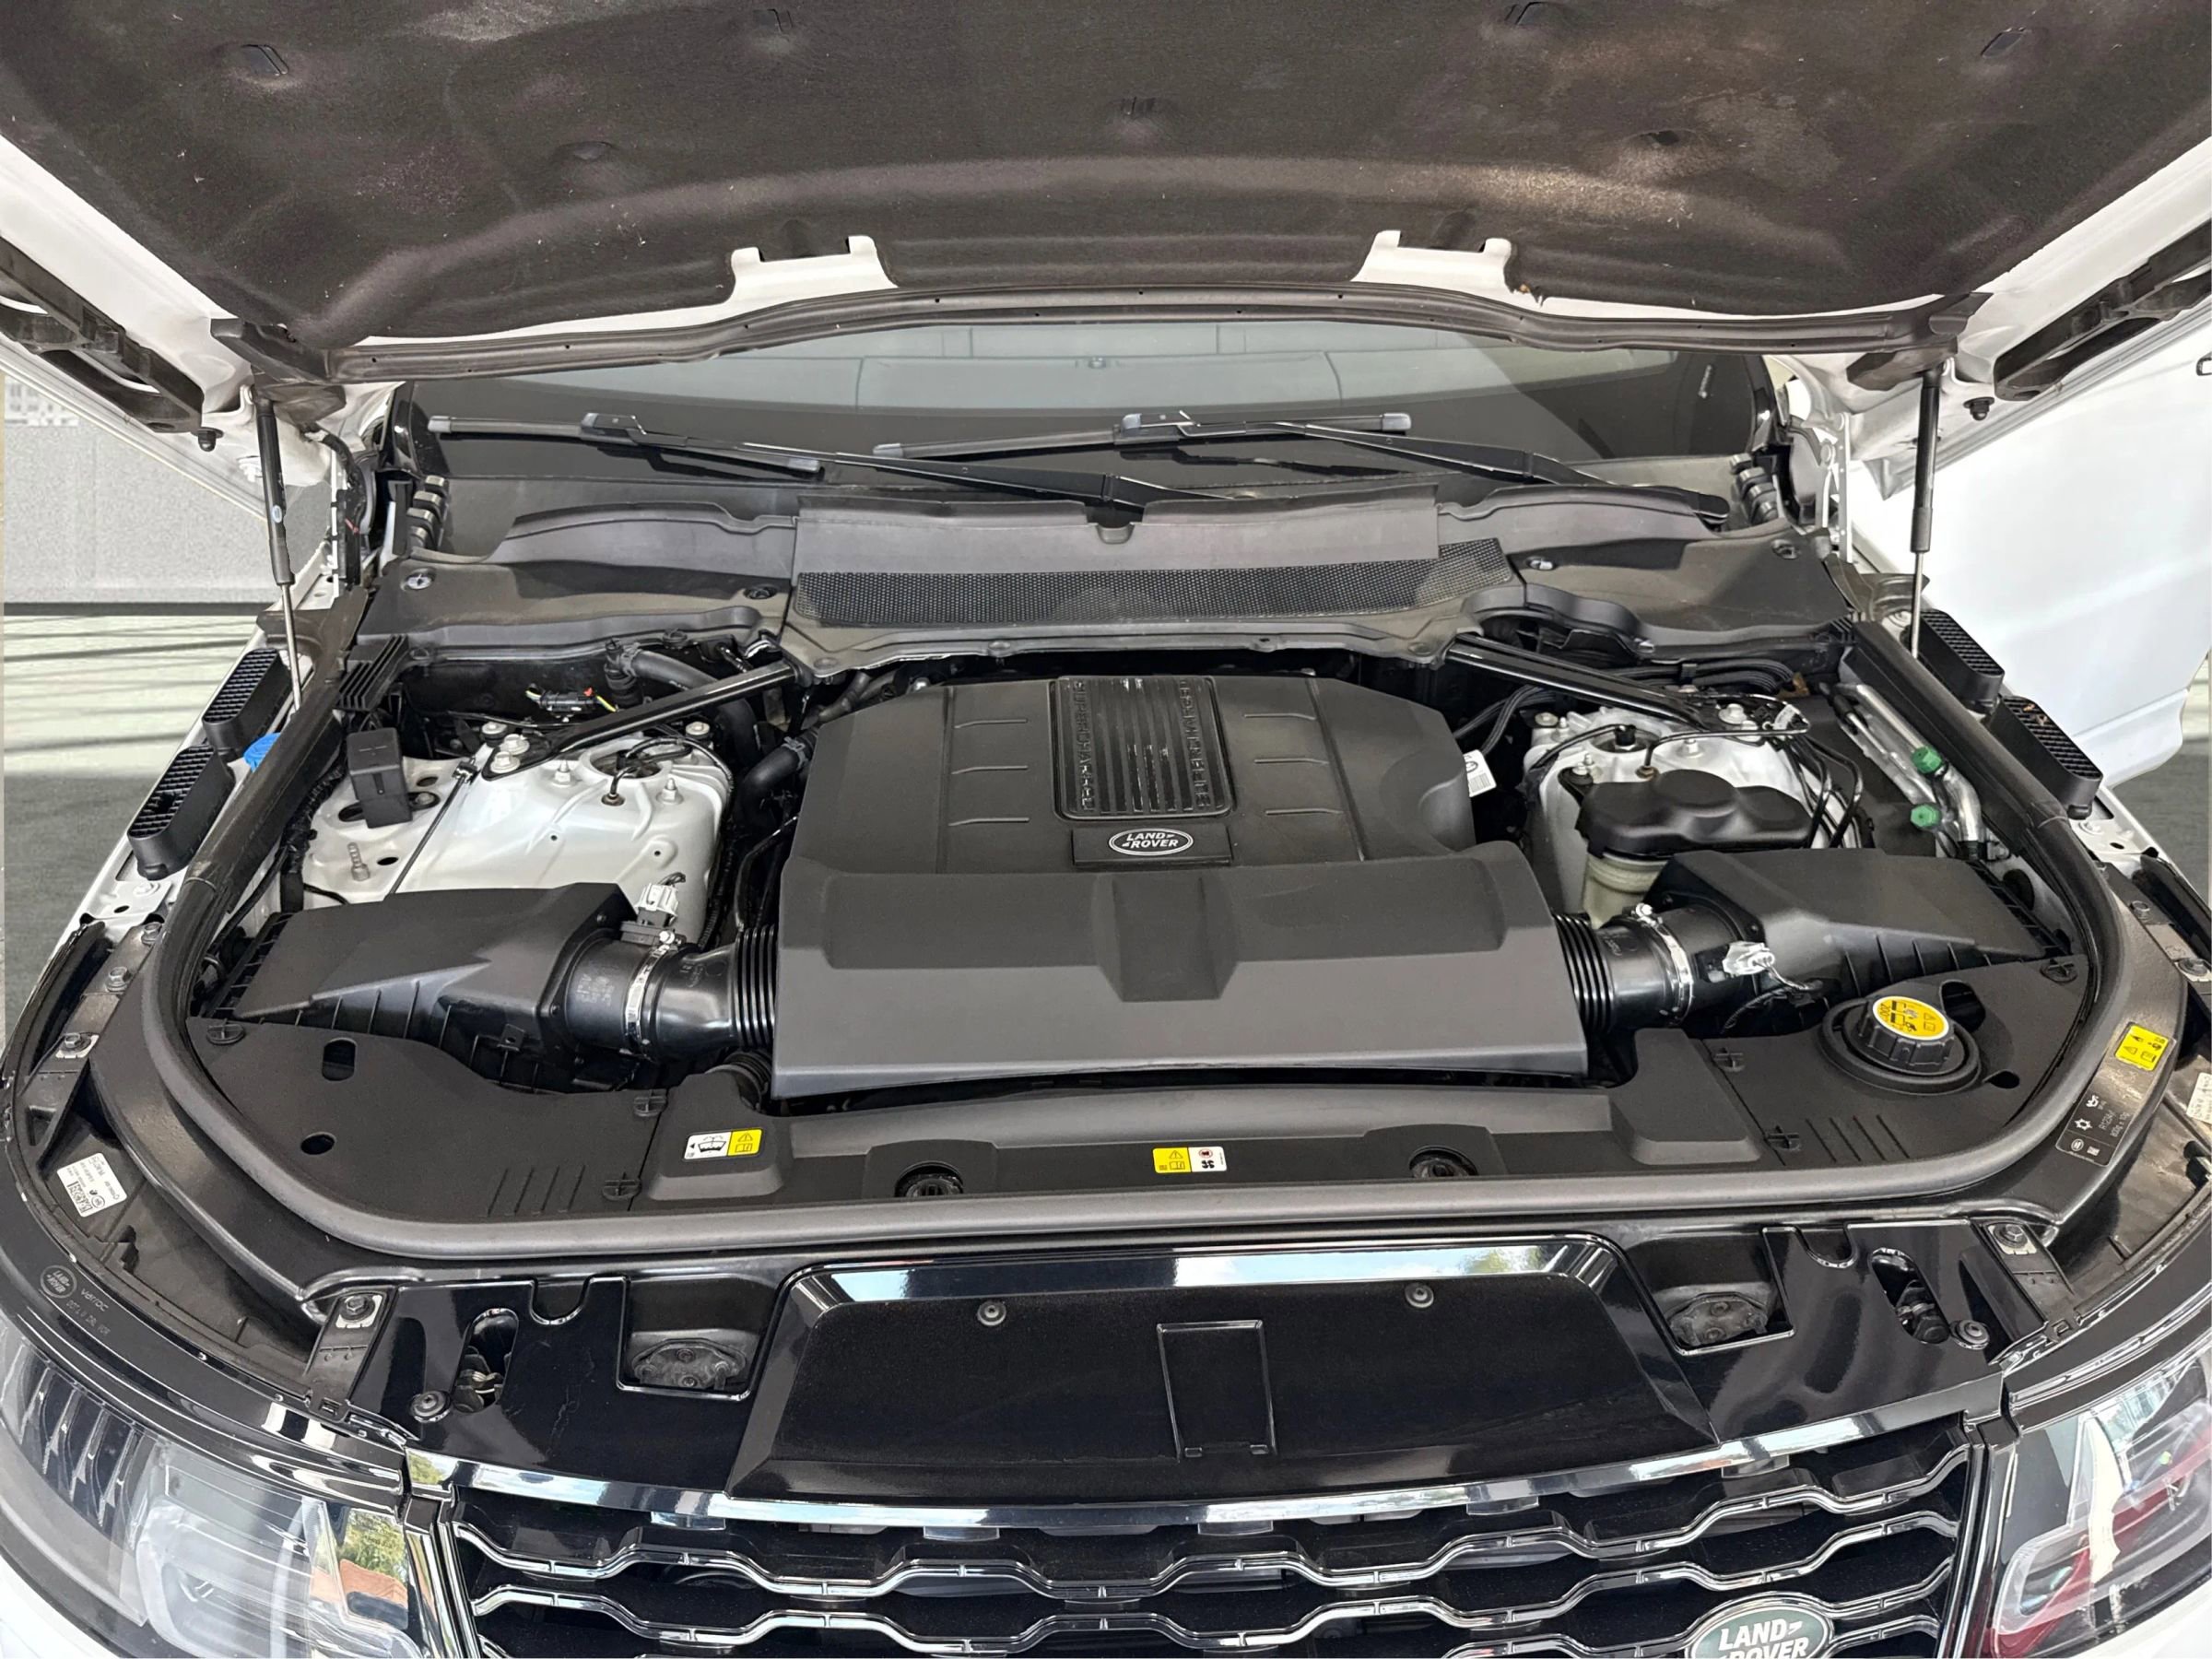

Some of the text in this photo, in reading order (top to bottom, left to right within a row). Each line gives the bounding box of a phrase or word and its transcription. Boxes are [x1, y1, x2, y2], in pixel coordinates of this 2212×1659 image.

[1073, 679, 1096, 812] SUPERCHARGED
[1126, 831, 1166, 841] LAND
[1130, 839, 1179, 849] ROVER
[47, 1277, 66, 1293] ROVER
[1718, 1618, 1787, 1651] LAND
